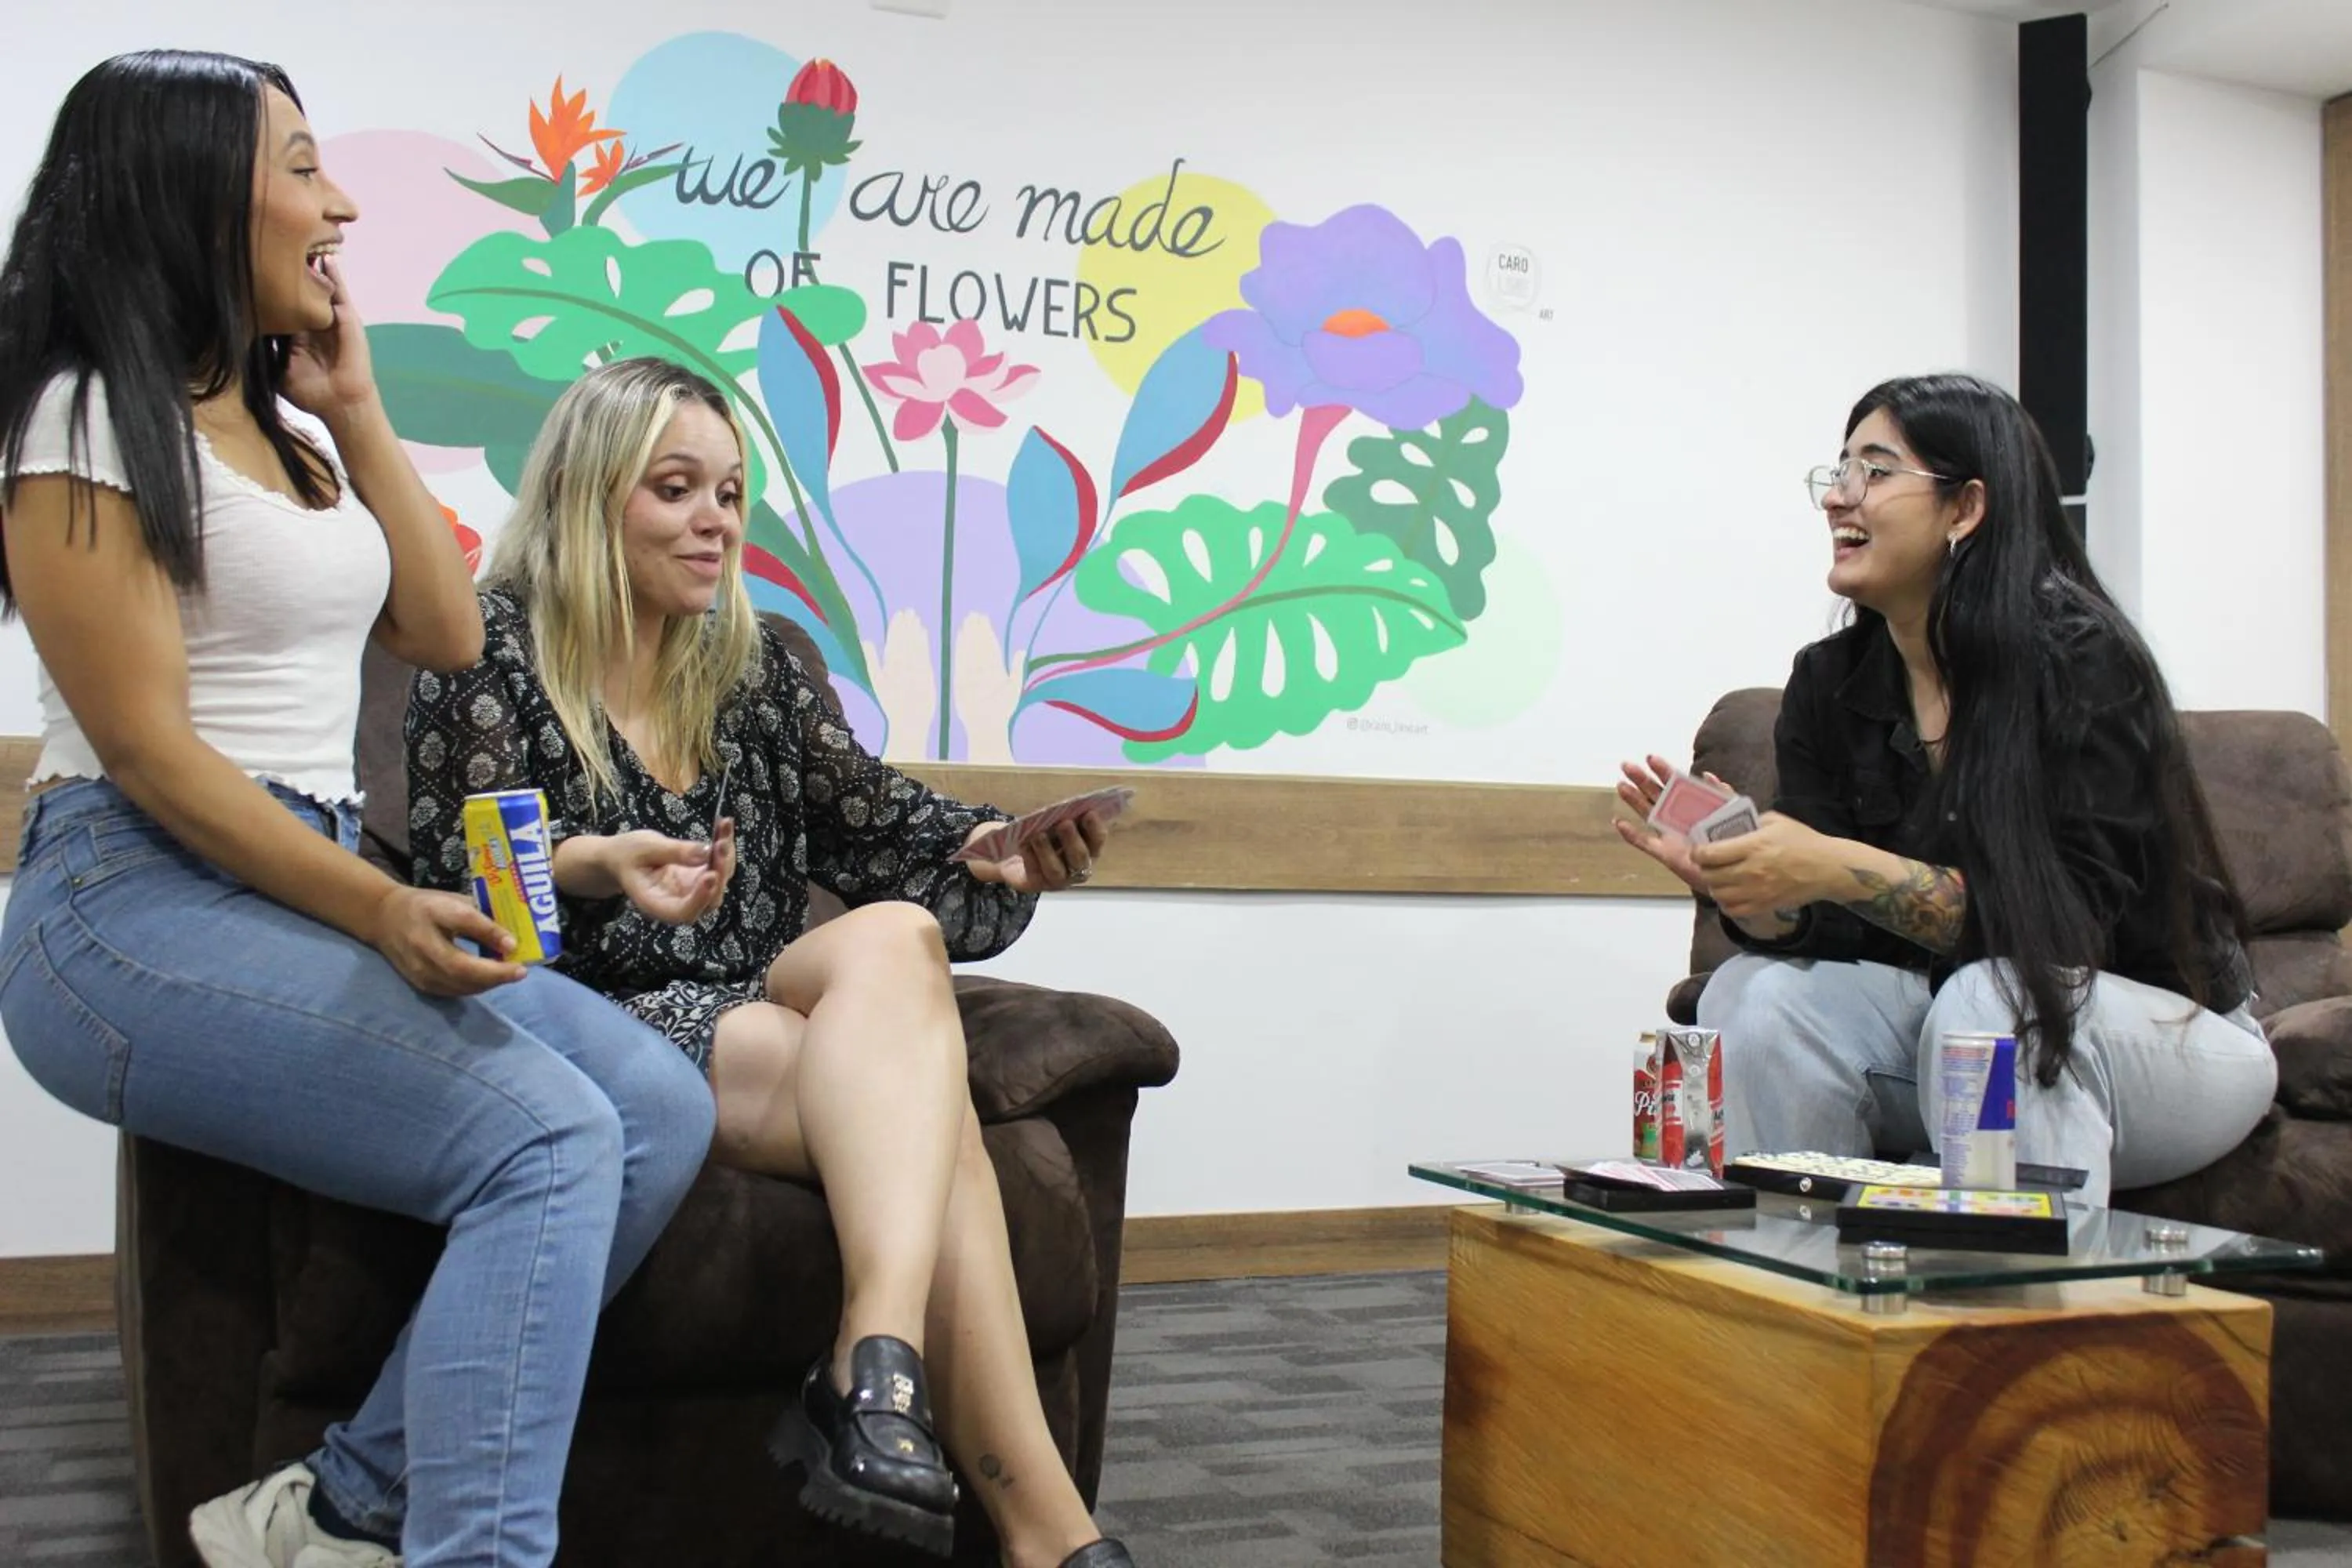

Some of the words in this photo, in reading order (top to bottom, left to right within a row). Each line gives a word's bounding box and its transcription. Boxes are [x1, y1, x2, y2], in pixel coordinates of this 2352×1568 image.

[675, 146, 790, 210] we
[849, 170, 990, 233] are
[1016, 158, 1226, 258] made
[745, 249, 822, 298] OF
[887, 261, 1138, 343] FLOWERS
[1498, 253, 1529, 274] CARO
